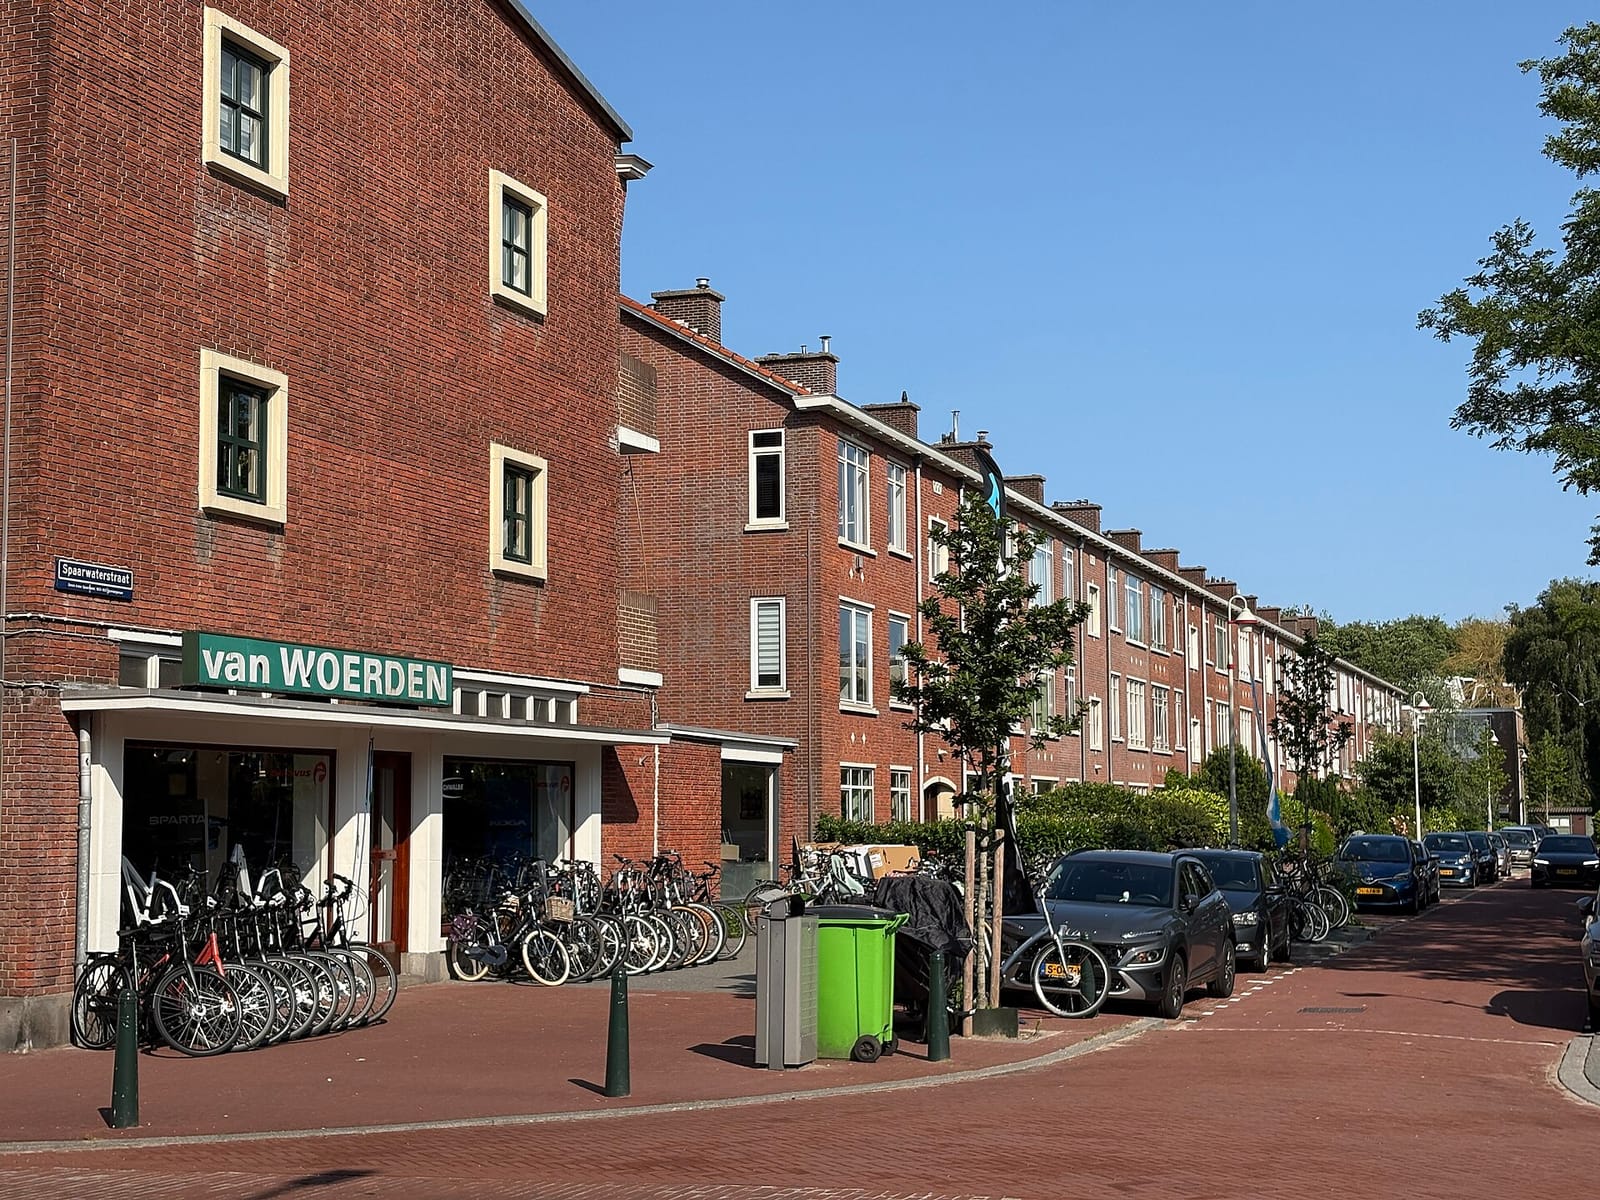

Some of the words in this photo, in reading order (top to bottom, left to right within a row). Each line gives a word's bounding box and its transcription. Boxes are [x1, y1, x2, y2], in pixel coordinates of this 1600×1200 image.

[62, 563, 130, 584] Spaarwaterstraat
[202, 649, 270, 684] van
[279, 647, 447, 701] WOERDEN
[149, 815, 206, 825] SPARTA
